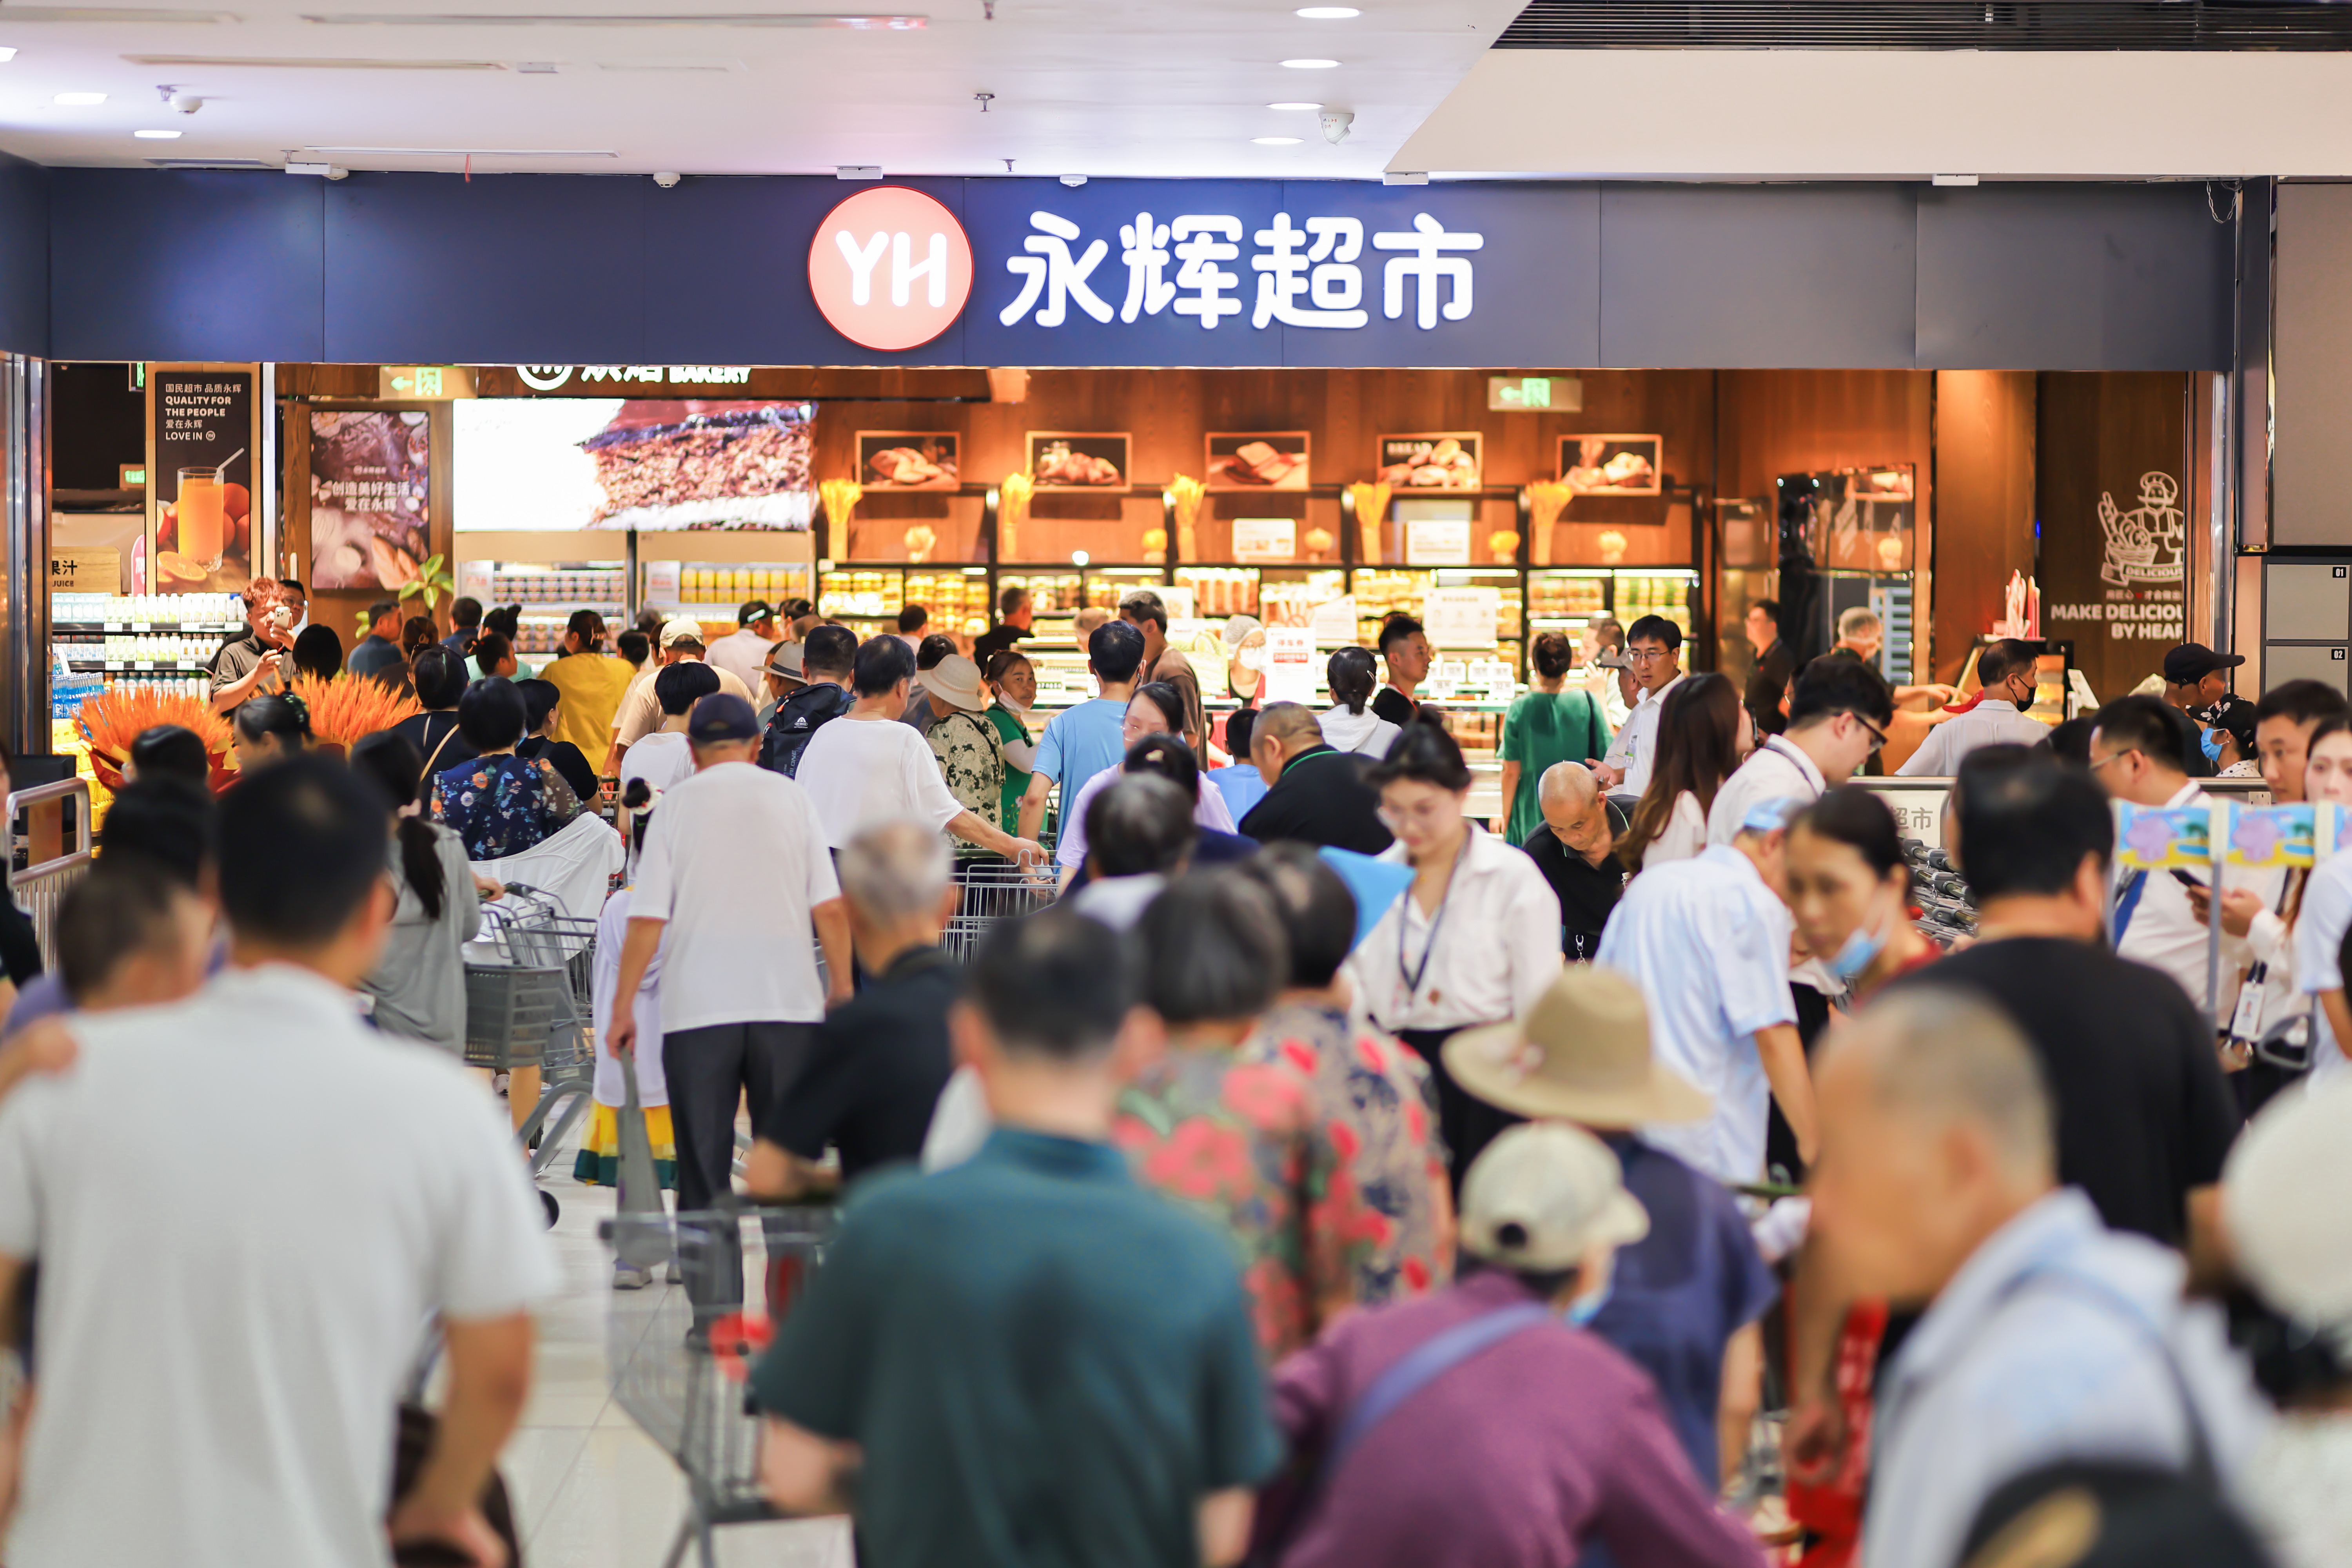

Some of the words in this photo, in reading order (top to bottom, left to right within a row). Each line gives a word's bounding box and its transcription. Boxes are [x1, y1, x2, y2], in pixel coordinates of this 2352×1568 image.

[836, 231, 946, 307] YH
[1001, 213, 1482, 328] 永辉超市
[669, 367, 751, 383] BAKERY
[166, 384, 201, 392] 国民超市
[205, 384, 241, 393] 品质永辉
[166, 396, 209, 405] QUALITY
[166, 419, 202, 428] 爱在永辉
[345, 497, 397, 512] 爱在永辉
[2336, 568, 2343, 577] 01
[2051, 604, 2102, 621] MAKE
[2111, 622, 2136, 640] BY
[2334, 650, 2342, 659] 02
